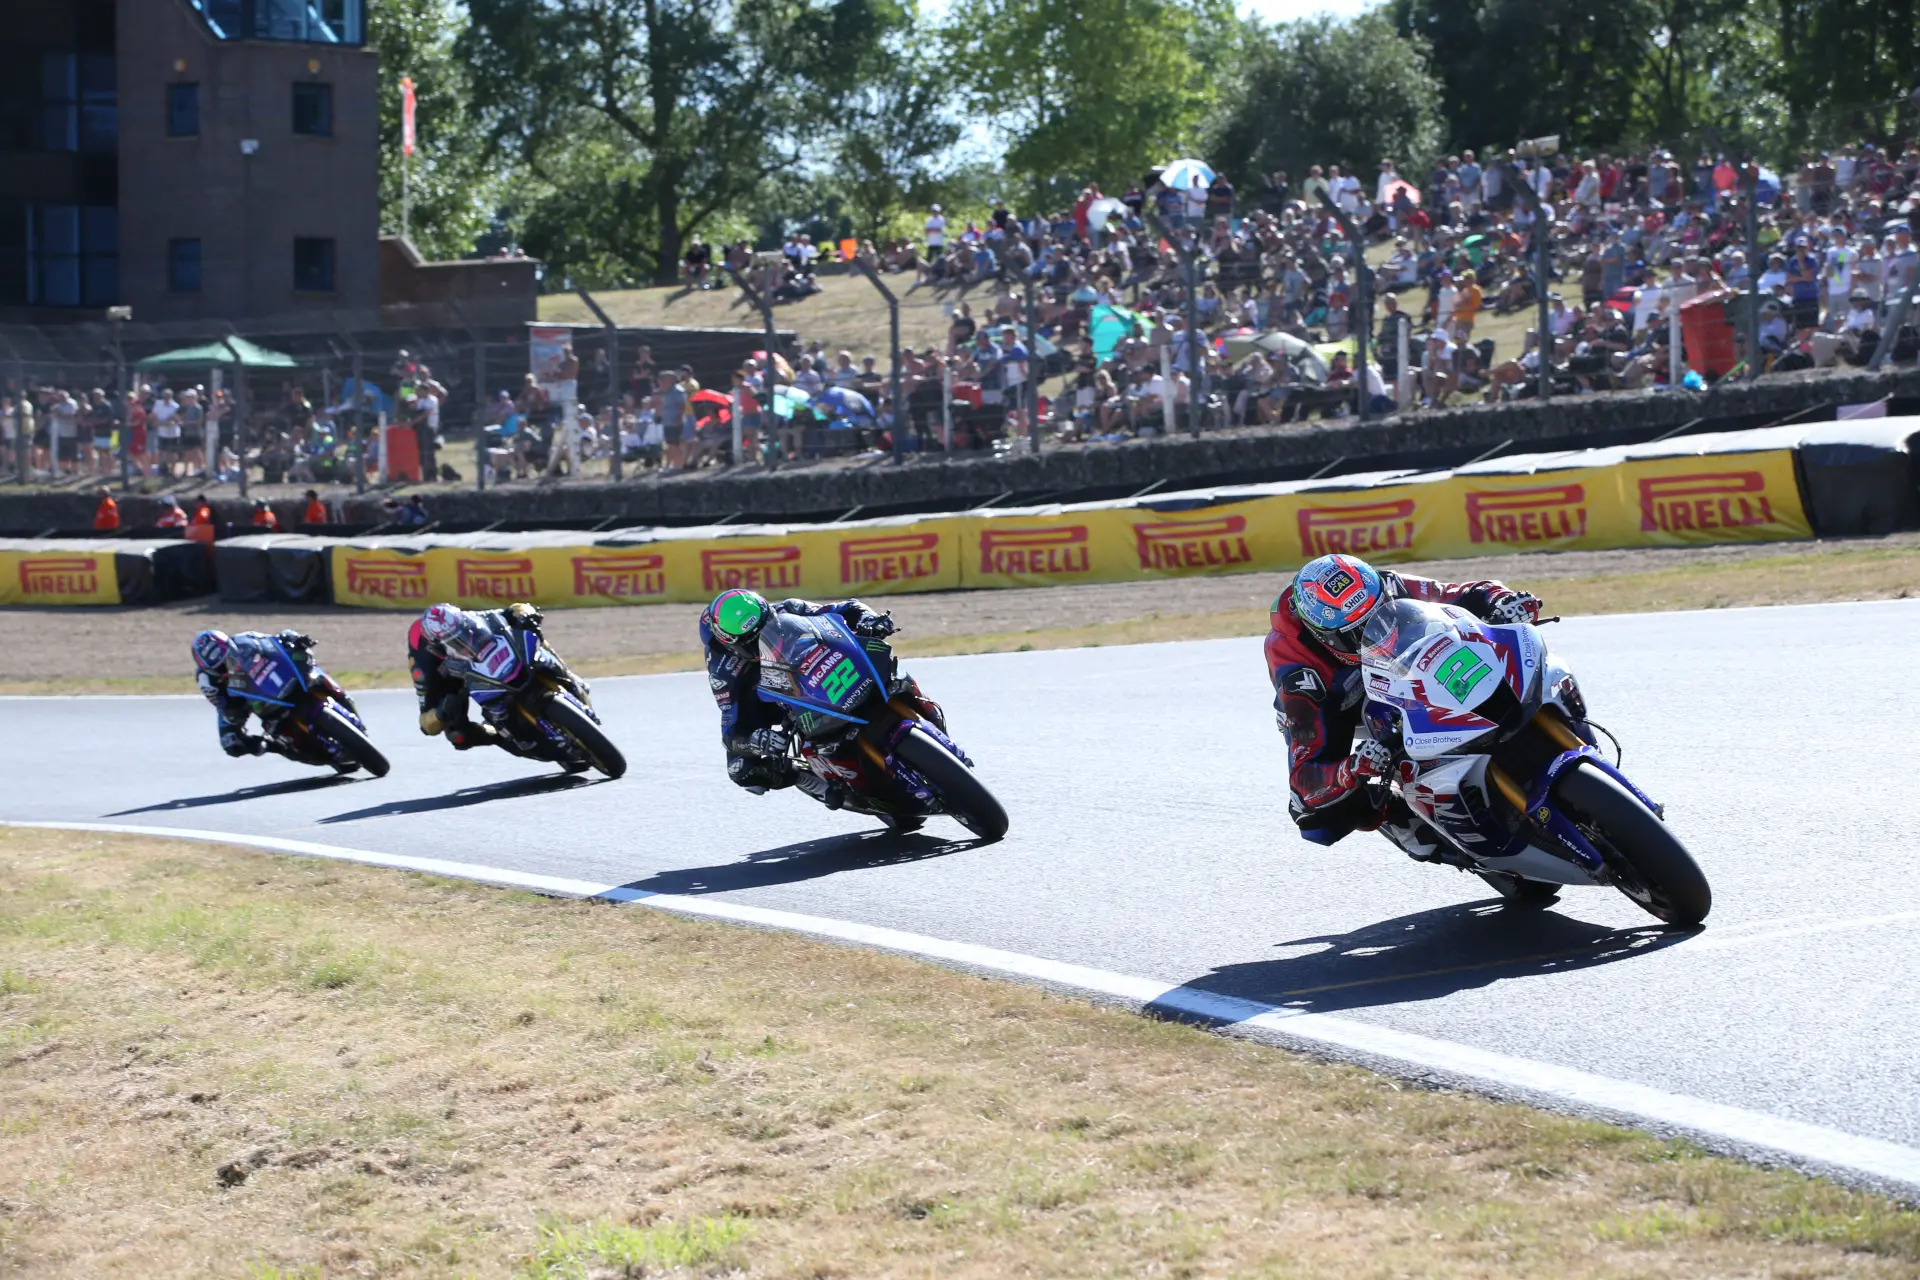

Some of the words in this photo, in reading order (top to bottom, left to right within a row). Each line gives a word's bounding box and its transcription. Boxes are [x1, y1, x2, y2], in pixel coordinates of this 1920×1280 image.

[1466, 484, 1587, 543] PIRELLI
[1638, 471, 1776, 532] PIRELLI
[1133, 516, 1252, 568] PIRELLI
[1298, 500, 1415, 557] PIRELLI
[701, 546, 801, 591] PIRELLI
[840, 533, 940, 583] PIRELLI
[980, 526, 1090, 573] PIRELLI
[19, 559, 97, 594] PIRELLI
[347, 558, 427, 598] PIRELLI
[458, 559, 536, 597] PIRELLI
[571, 554, 665, 596] PIRELLI
[1327, 574, 1344, 589] fona
[1331, 577, 1351, 594] CAB
[1344, 590, 1366, 611] SHOEI
[269, 671, 284, 687] 1
[808, 651, 843, 688] McAMS
[821, 658, 861, 704] 22
[1371, 680, 1389, 692] MOTUL
[842, 677, 873, 711] MONSTER
[1432, 736, 1462, 744] Brothers
